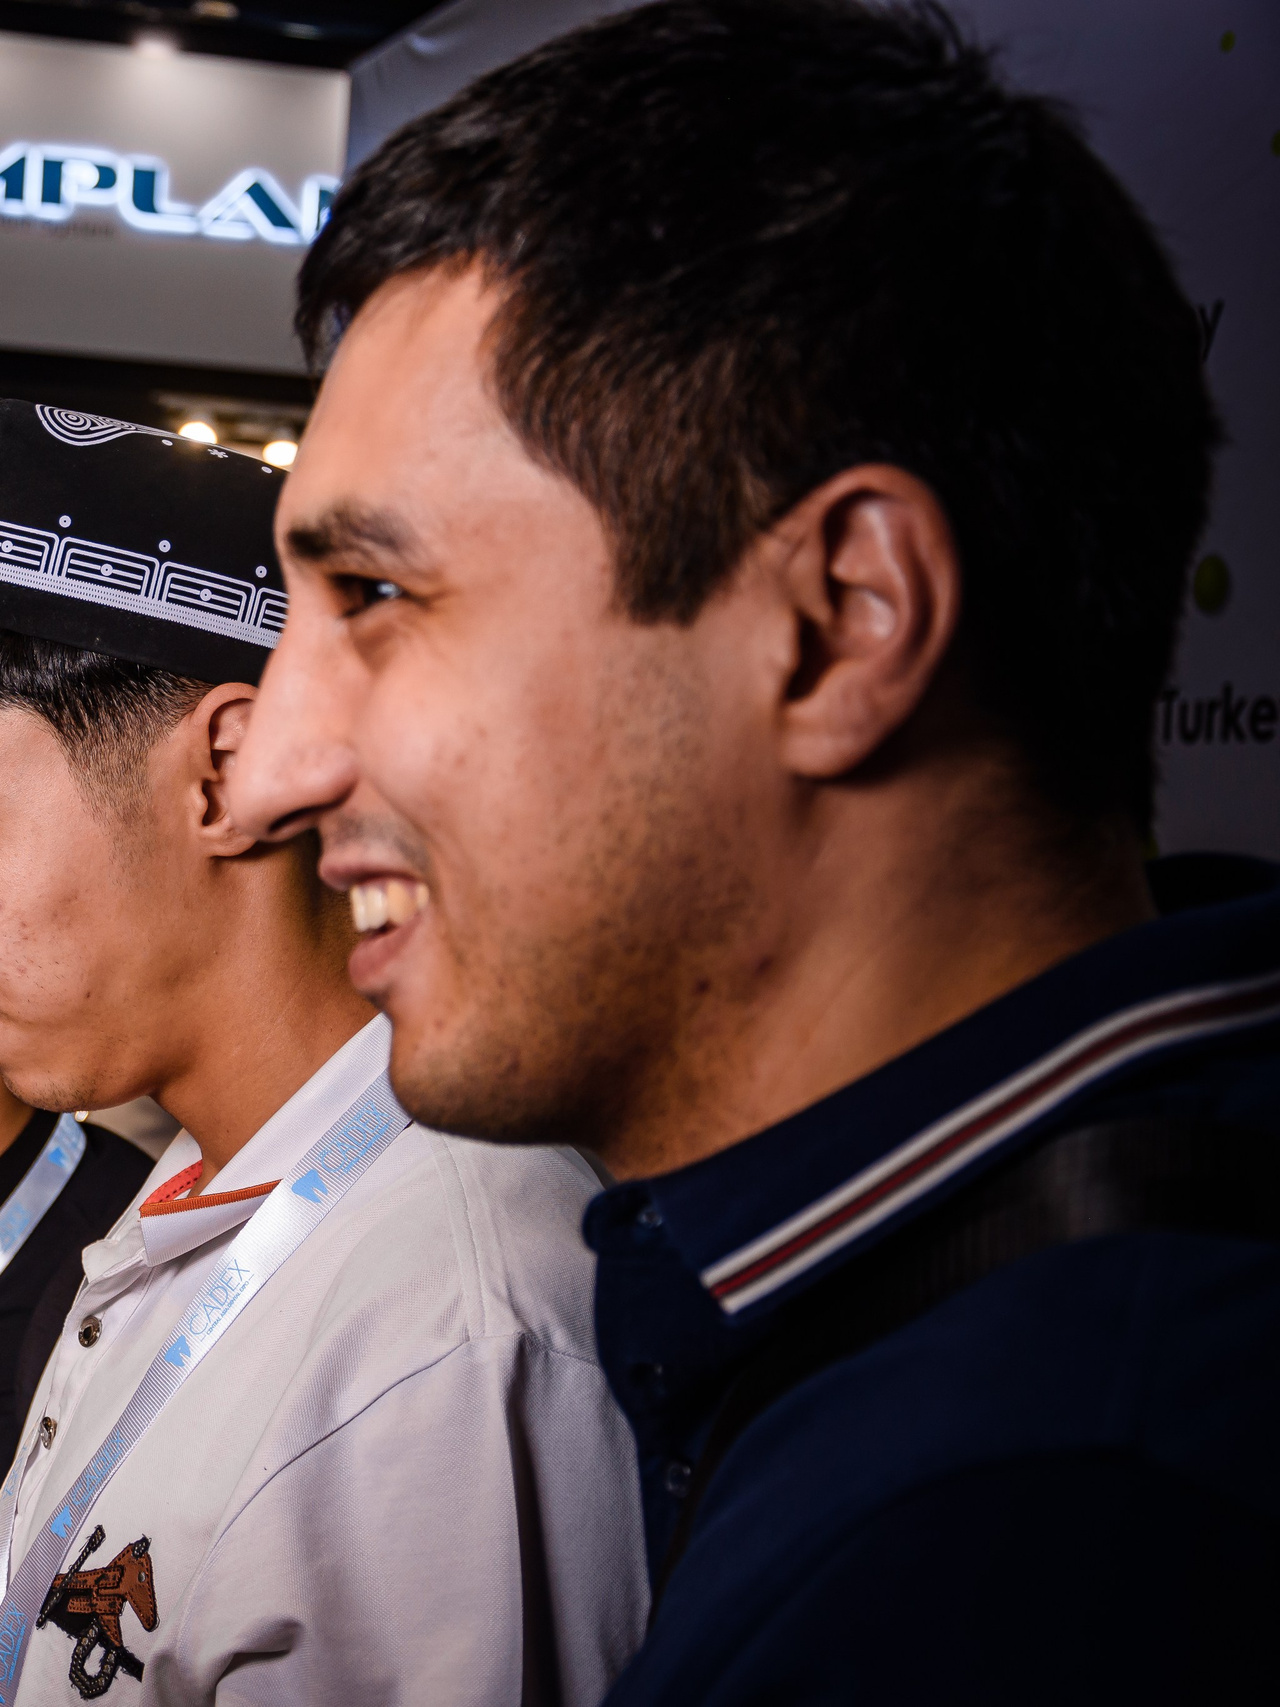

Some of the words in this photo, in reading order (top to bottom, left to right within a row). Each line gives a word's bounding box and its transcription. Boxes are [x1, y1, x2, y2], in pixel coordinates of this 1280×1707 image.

[1161, 681, 1280, 745] Turke
[320, 1100, 392, 1173] CADEX
[189, 1258, 251, 1335] CADEX
[70, 1430, 124, 1506] CADEX
